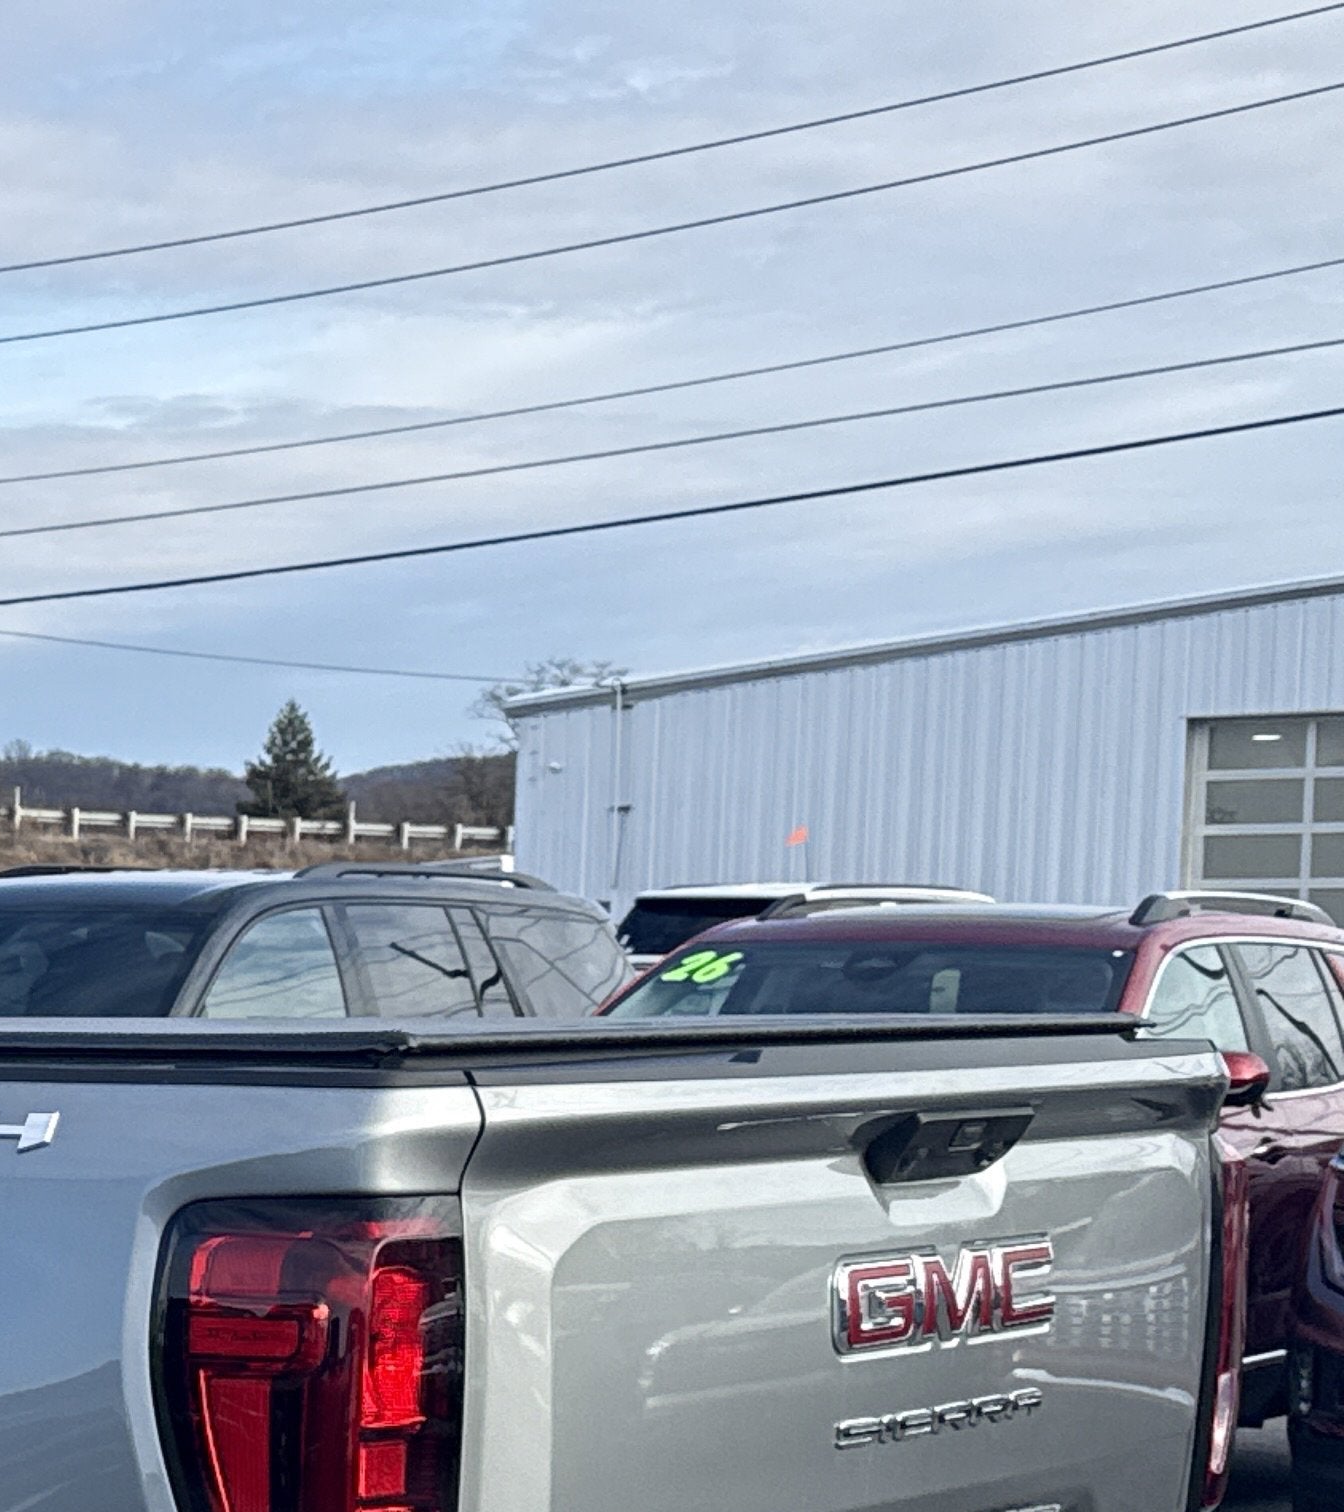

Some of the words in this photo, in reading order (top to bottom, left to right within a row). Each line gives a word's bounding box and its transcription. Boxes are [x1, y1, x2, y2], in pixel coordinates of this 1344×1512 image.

[661, 950, 744, 984] 26
[831, 1237, 1055, 1357] GMC
[833, 1386, 1043, 1450] SIERRA
